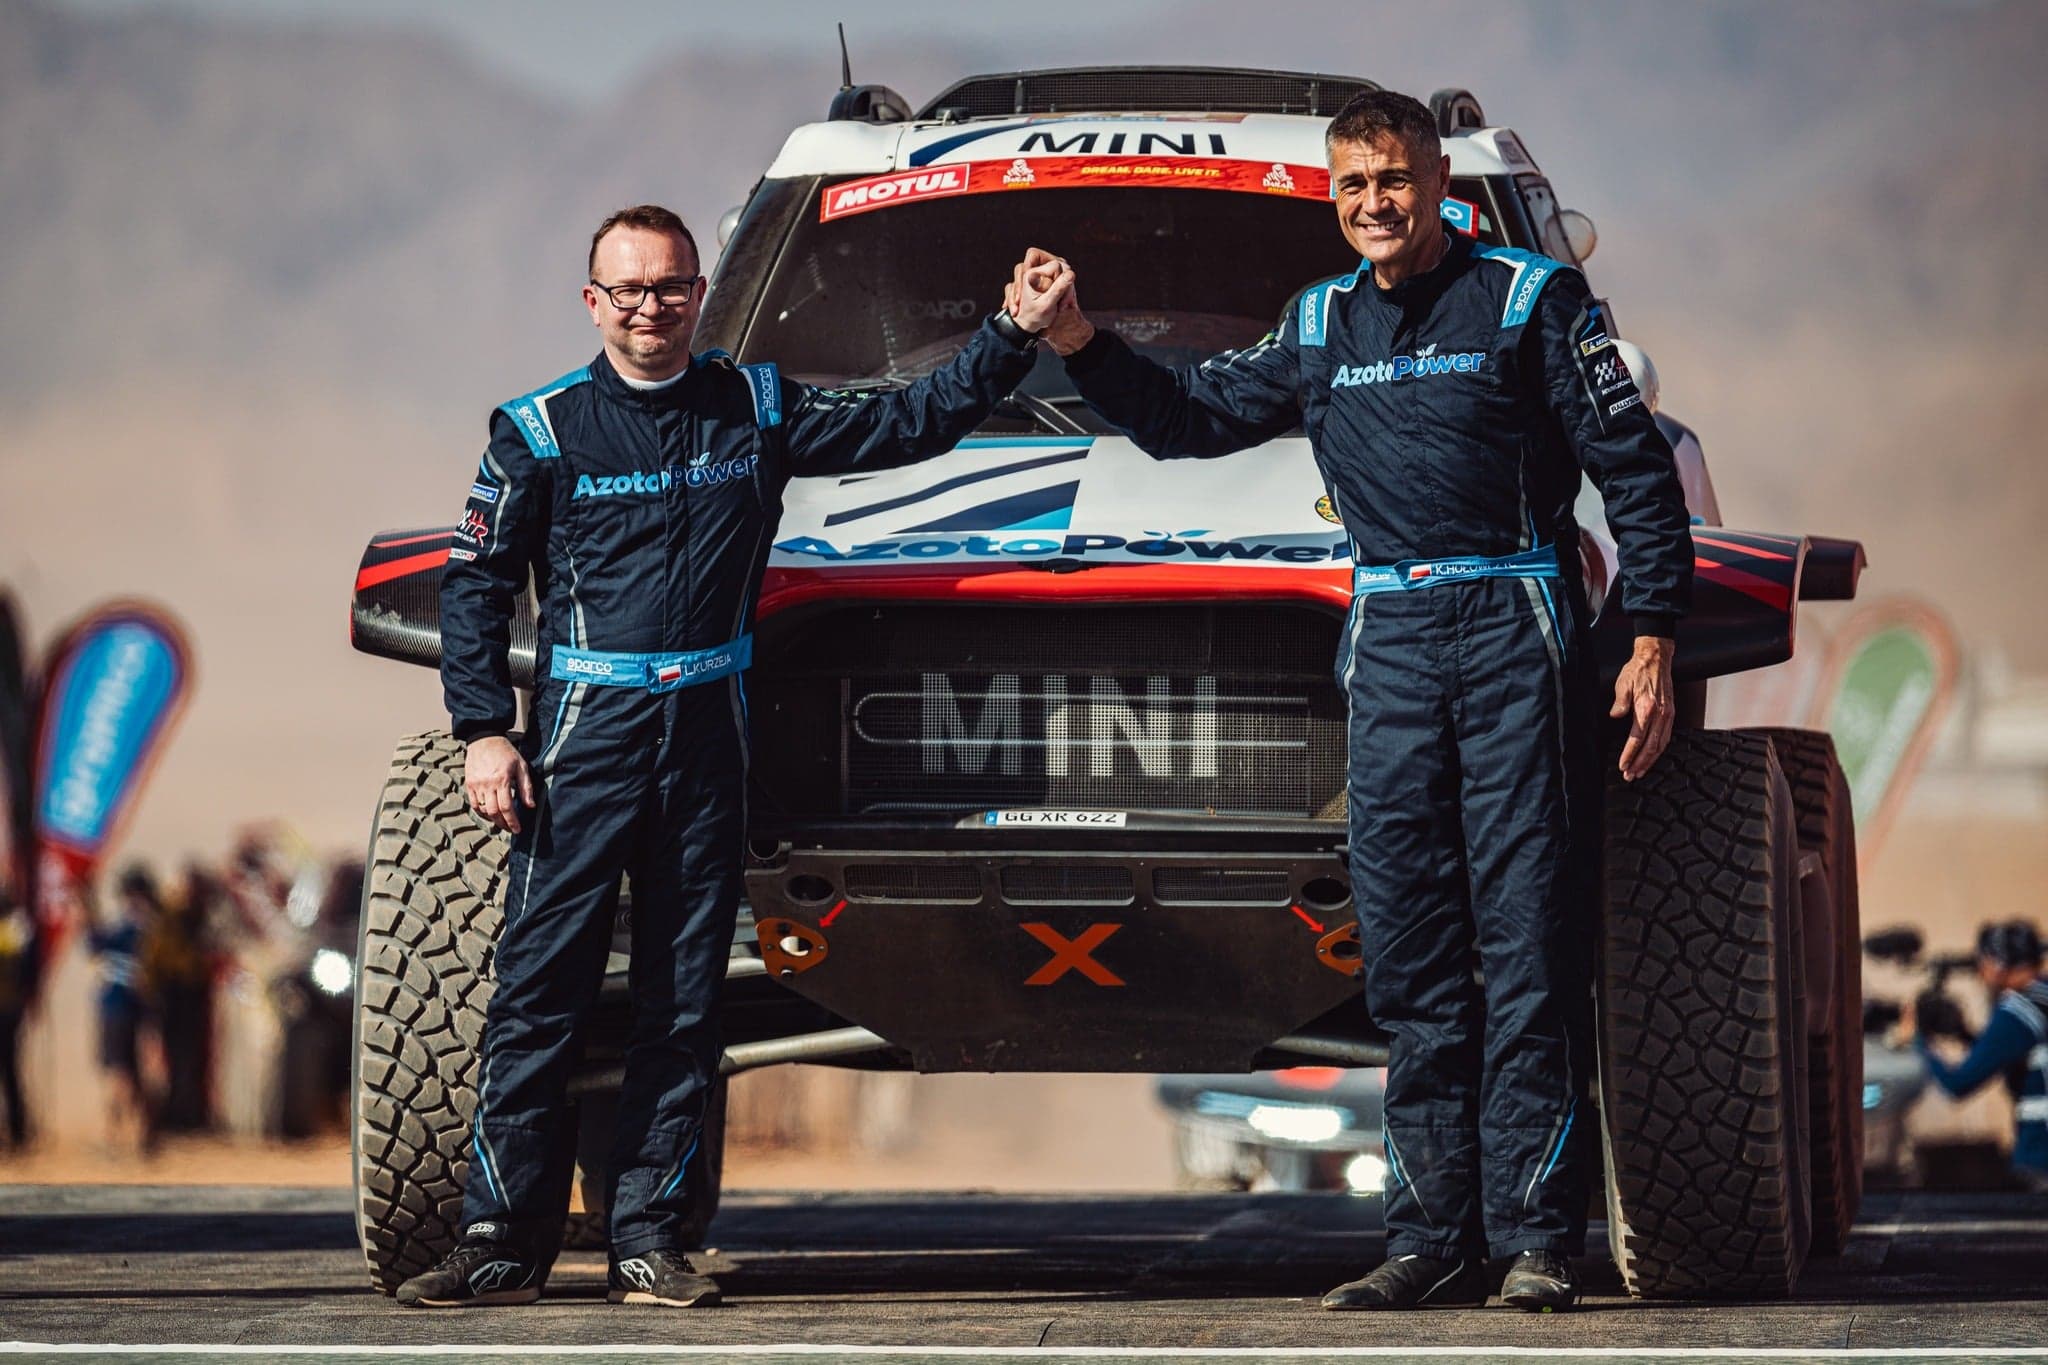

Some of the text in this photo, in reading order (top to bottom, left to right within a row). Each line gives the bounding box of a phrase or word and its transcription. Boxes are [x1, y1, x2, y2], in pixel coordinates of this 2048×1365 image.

[1018, 132, 1227, 155] MINI
[834, 171, 960, 210] MOTUL
[1081, 166, 1131, 175] DREAM.
[1133, 166, 1173, 175] DARE.
[1174, 167, 1203, 176] LIVE
[1262, 177, 1296, 191] DAKAR
[1515, 268, 1547, 312] sparco
[759, 367, 775, 411] sparco
[1331, 350, 1486, 389] AzotoPower
[517, 406, 549, 447] sparco
[572, 454, 760, 500] AzotoPower
[567, 657, 613, 675] sparco
[921, 673, 1218, 777] MINI
